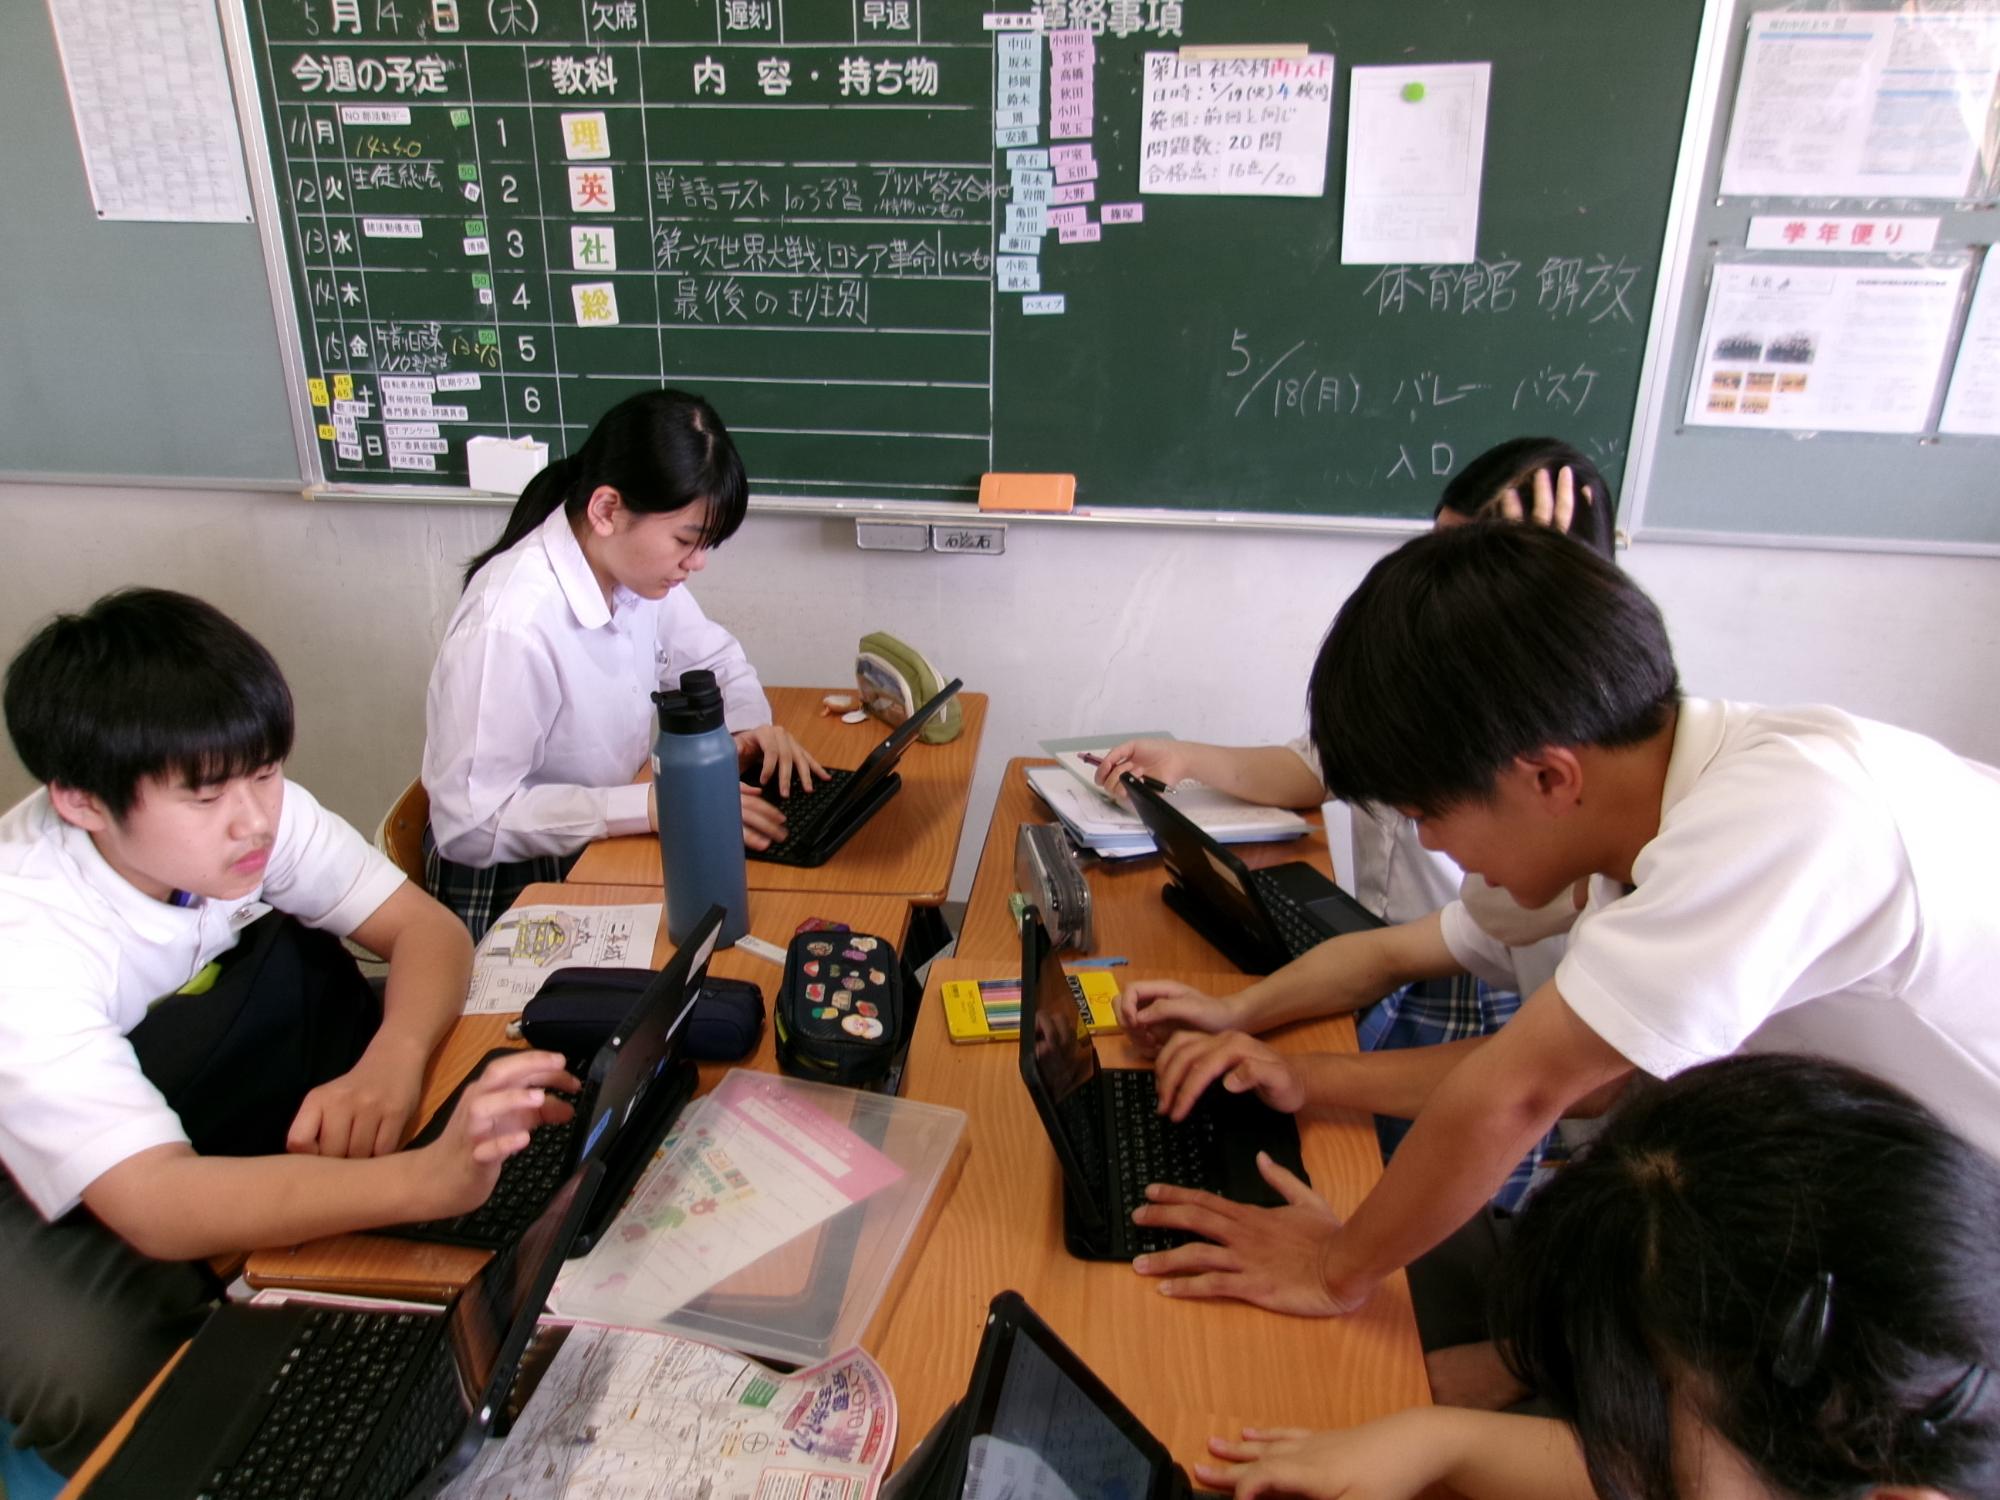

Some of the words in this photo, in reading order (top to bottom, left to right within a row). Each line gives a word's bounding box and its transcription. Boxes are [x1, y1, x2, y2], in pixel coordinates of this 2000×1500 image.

[591, 1, 639, 32] 欠席
[724, 1, 773, 31] 遅刻
[862, 1, 911, 31] 早退
[1031, 0, 1183, 38] 連絡事項
[291, 54, 448, 94] 今週の予定
[551, 55, 618, 96] 教科
[316, 120, 335, 145] 月
[496, 118, 507, 148] 1
[569, 118, 604, 152] 理
[325, 176, 346, 201] 火
[501, 174, 519, 204] 2
[576, 172, 609, 207] 英
[333, 230, 352, 253] 水
[507, 229, 524, 258] 3
[1783, 221, 1904, 245] 学年便り
[579, 232, 611, 265] 社
[340, 281, 361, 307] 木
[512, 282, 531, 311] 4
[1535, 254, 1641, 323] 解放
[579, 288, 612, 321] 総
[349, 334, 369, 358] 金
[517, 335, 536, 362] 5
[523, 387, 541, 413] 6
[1511, 361, 1600, 418] バスケ
[366, 435, 383, 456] 日
